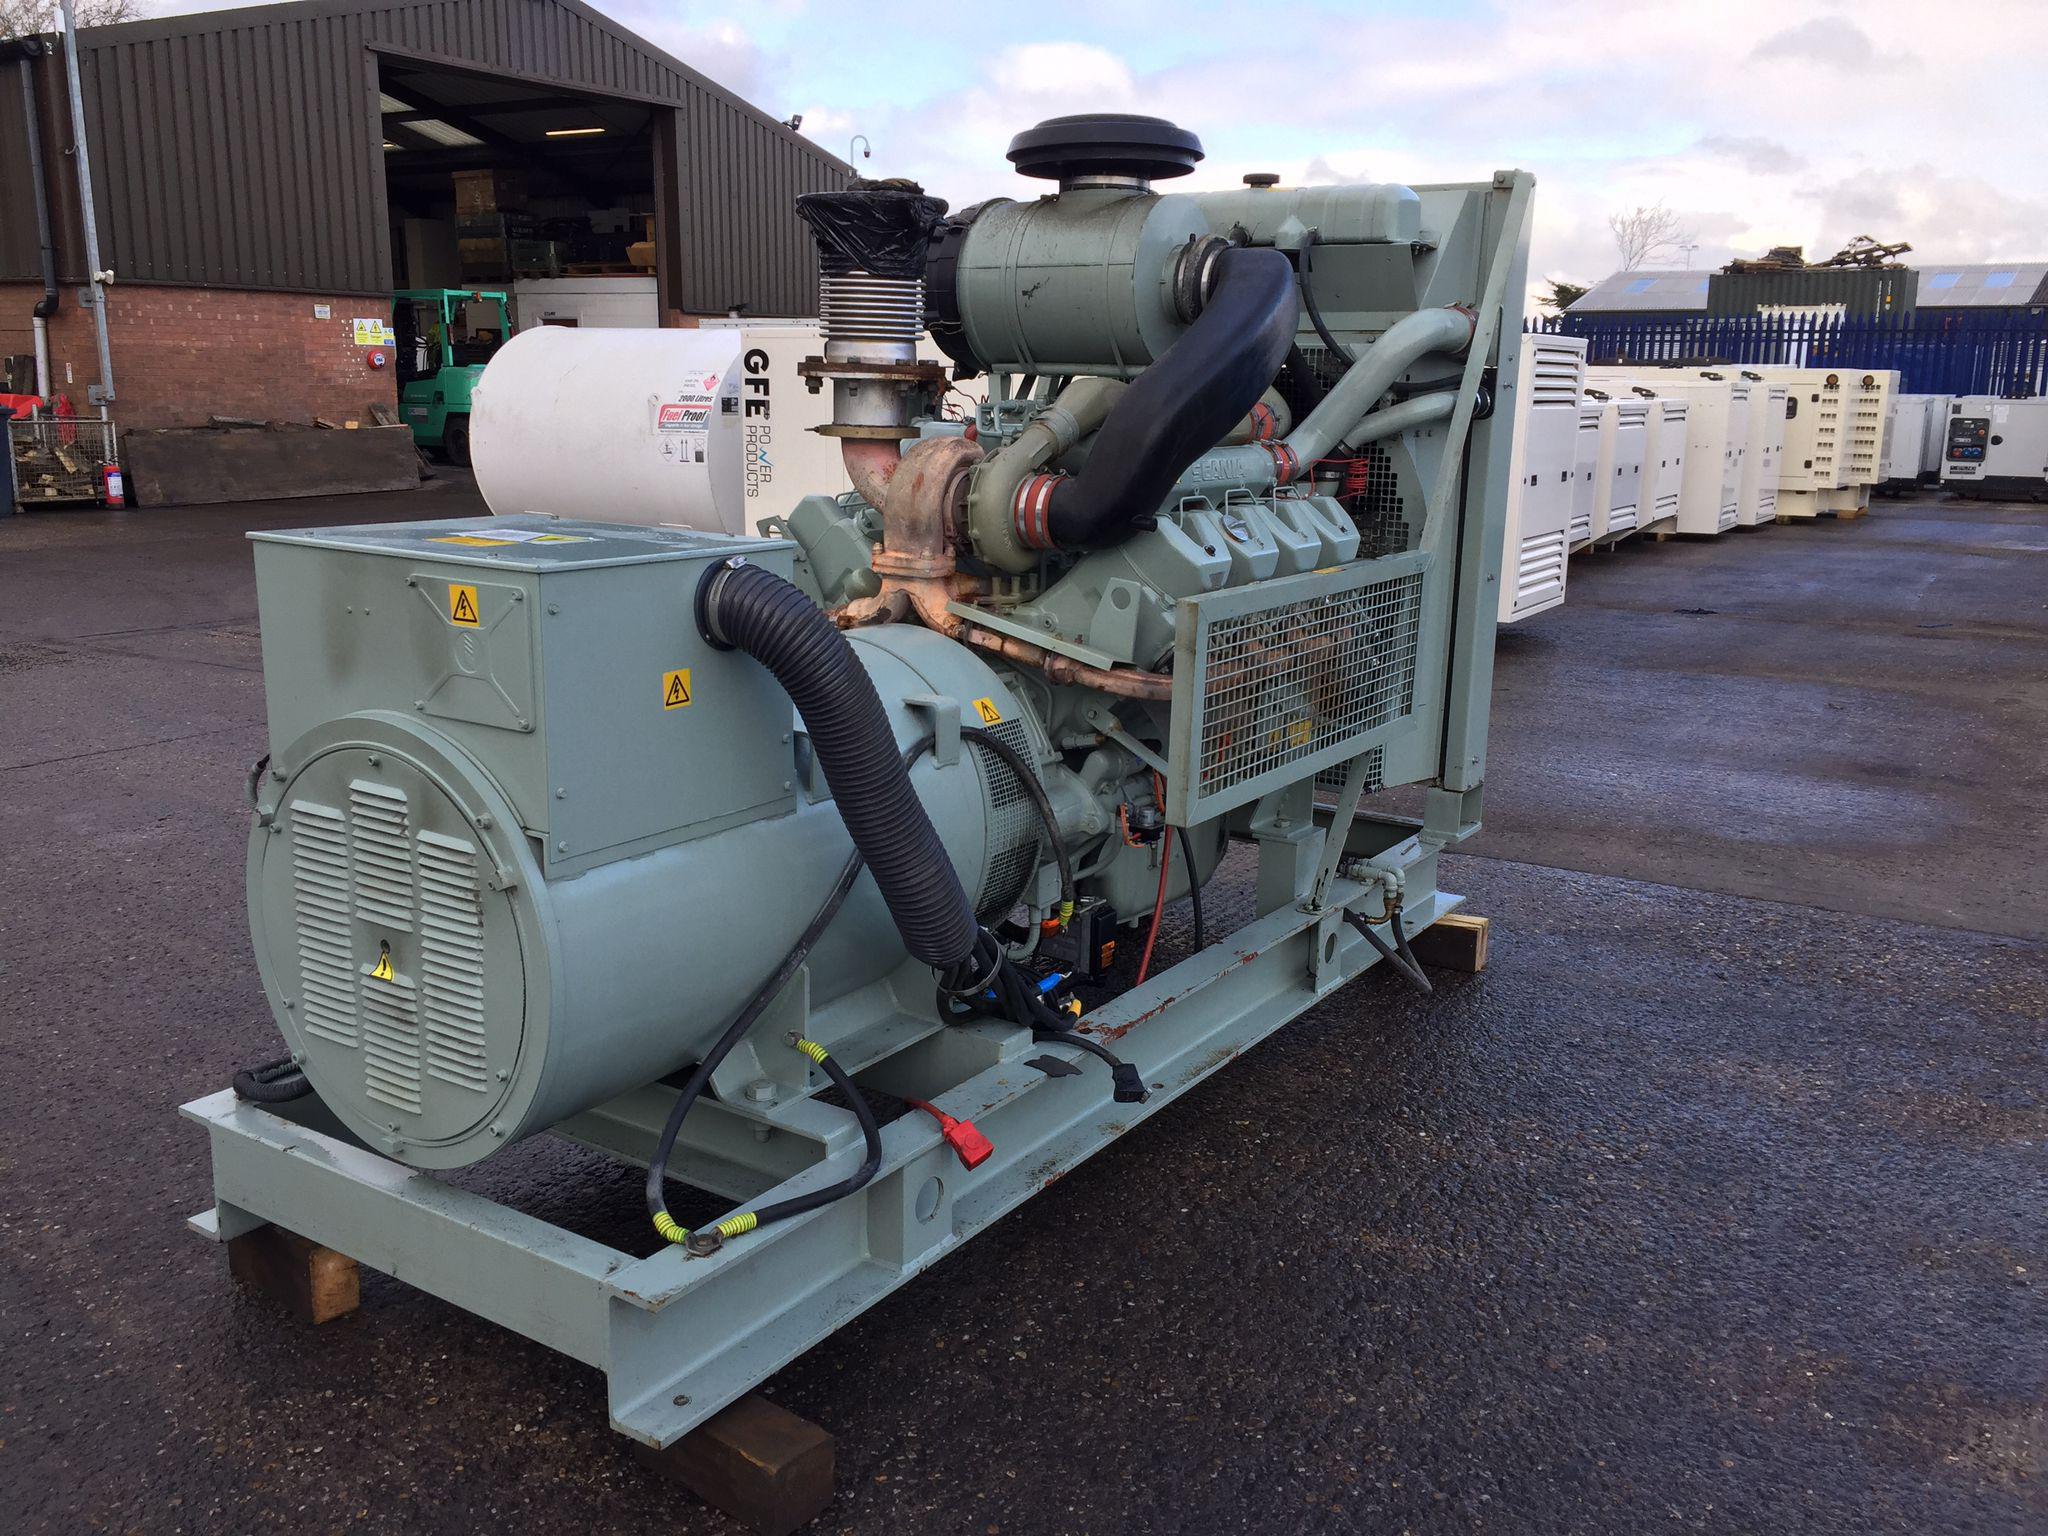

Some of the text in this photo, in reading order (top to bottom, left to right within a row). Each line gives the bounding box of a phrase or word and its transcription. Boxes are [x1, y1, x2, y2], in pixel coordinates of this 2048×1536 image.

[663, 409, 706, 421] Fuel Proof
[744, 348, 770, 418] GFE
[745, 425, 760, 498] PRODUCTS
